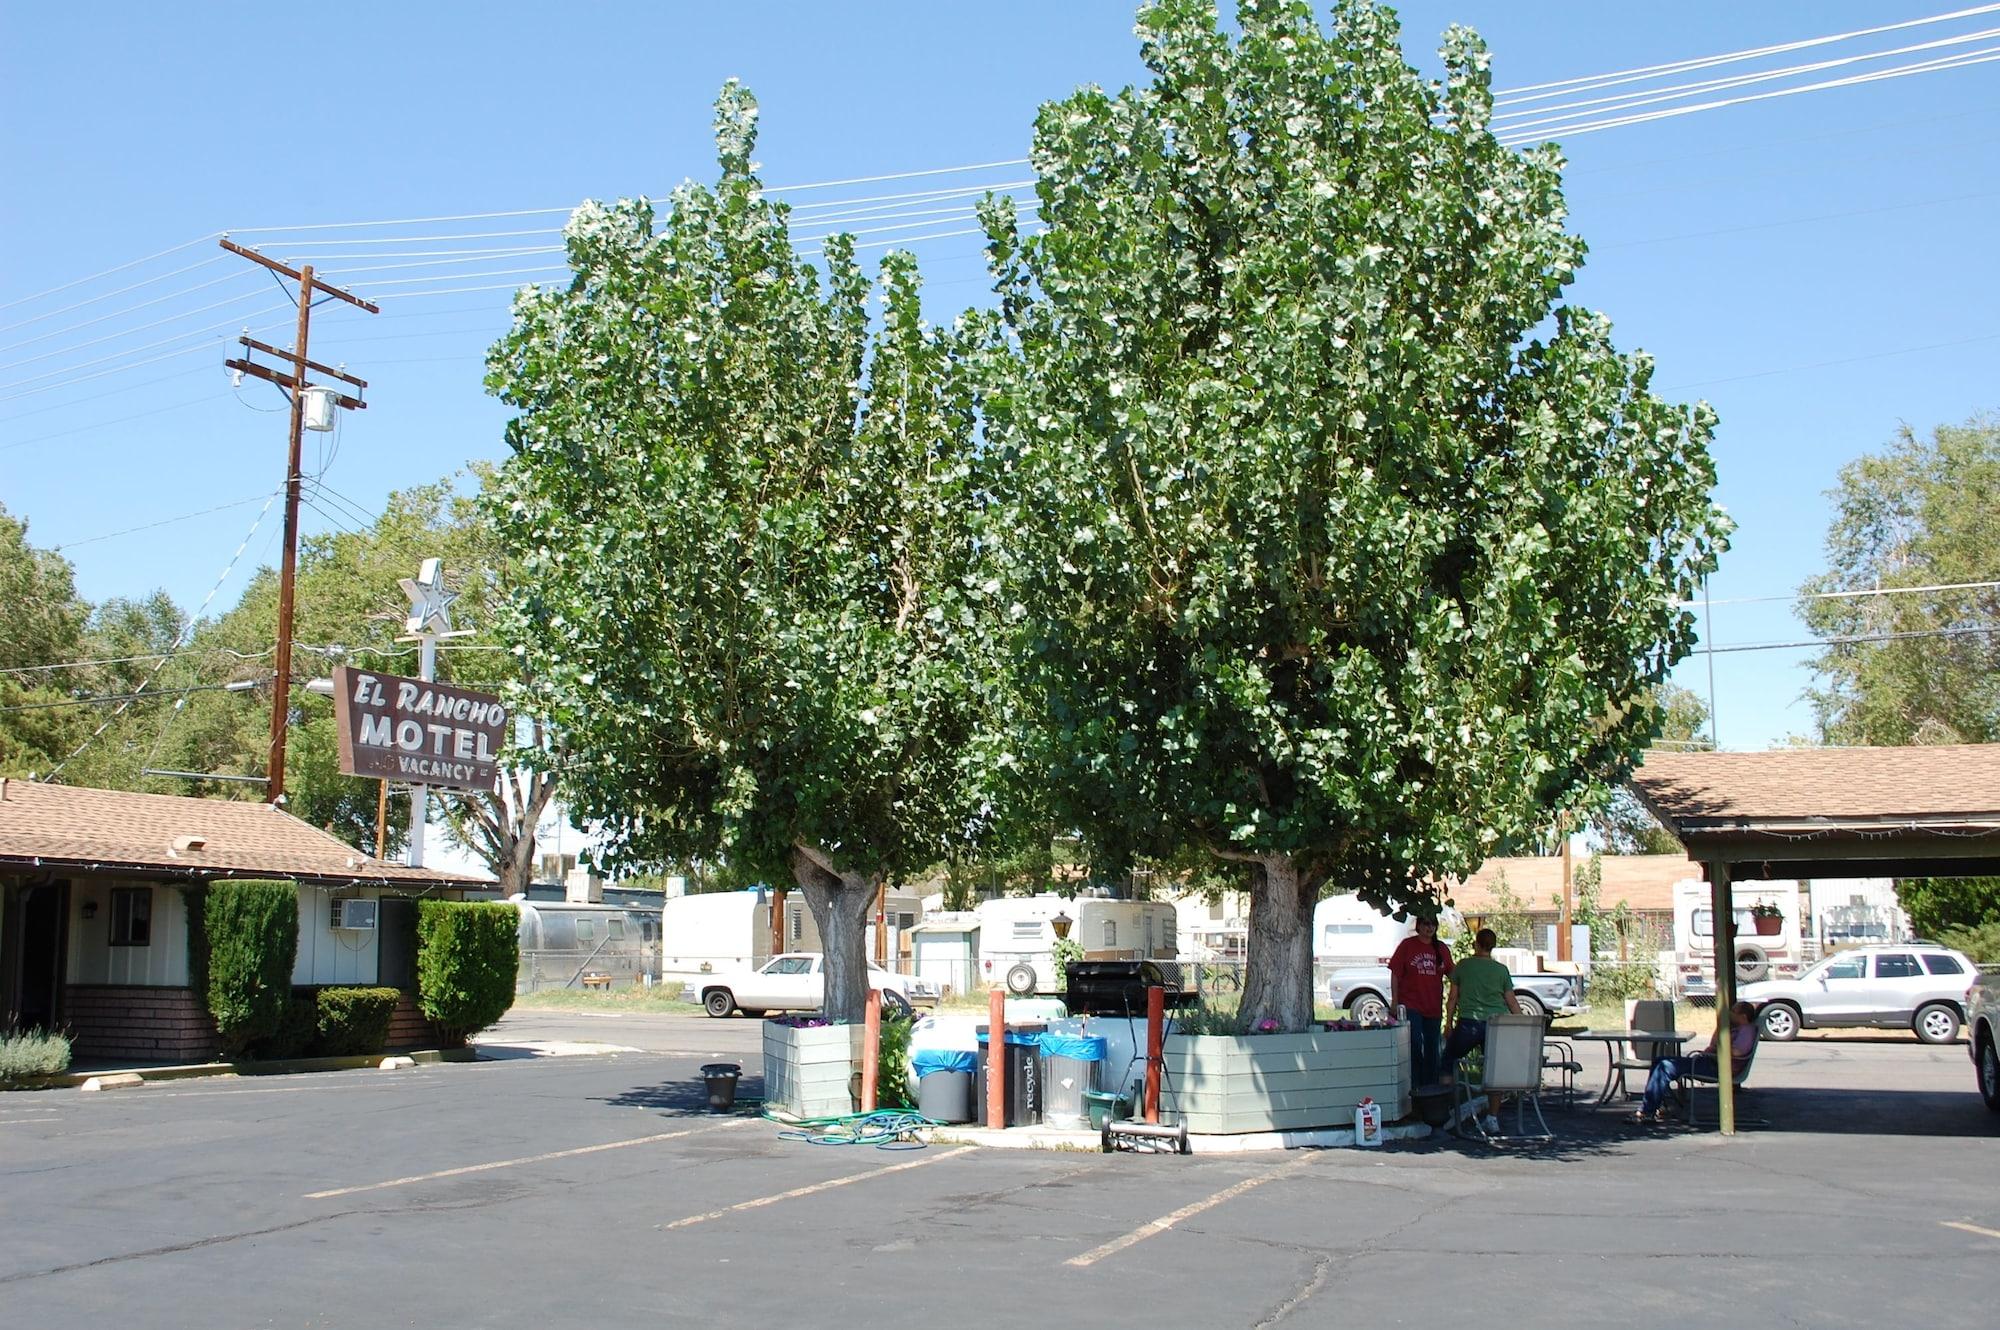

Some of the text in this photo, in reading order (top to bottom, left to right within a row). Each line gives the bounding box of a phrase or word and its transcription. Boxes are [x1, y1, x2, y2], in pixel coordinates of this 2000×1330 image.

[354, 674, 505, 727] EL RANCHO
[359, 713, 496, 762] MOTEL
[398, 756, 475, 781] VACANCY
[1024, 1056, 1036, 1109] recycle
